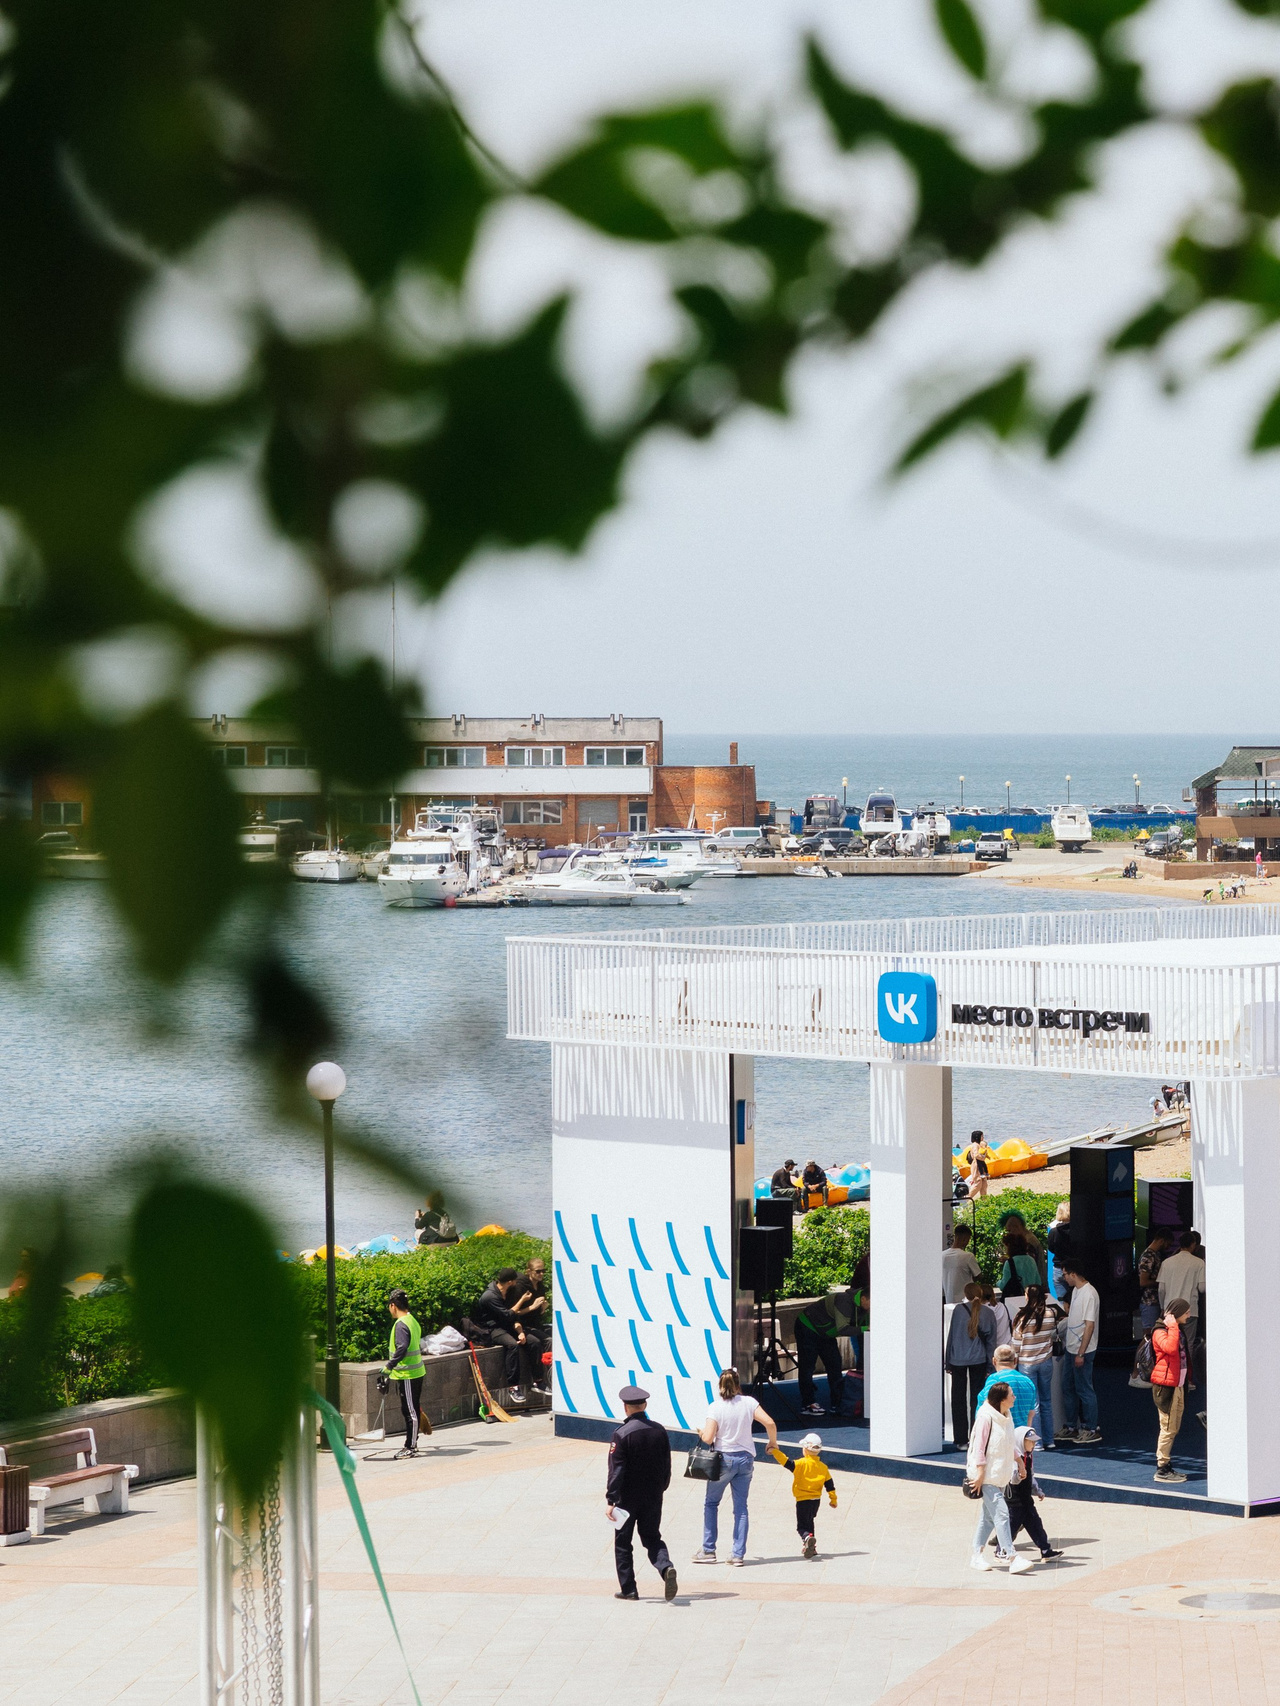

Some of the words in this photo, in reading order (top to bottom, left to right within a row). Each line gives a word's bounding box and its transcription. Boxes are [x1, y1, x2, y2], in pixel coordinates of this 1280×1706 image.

[885, 992, 918, 1025] VK
[951, 1003, 1034, 1028] место
[1038, 1007, 1150, 1038] встречи
